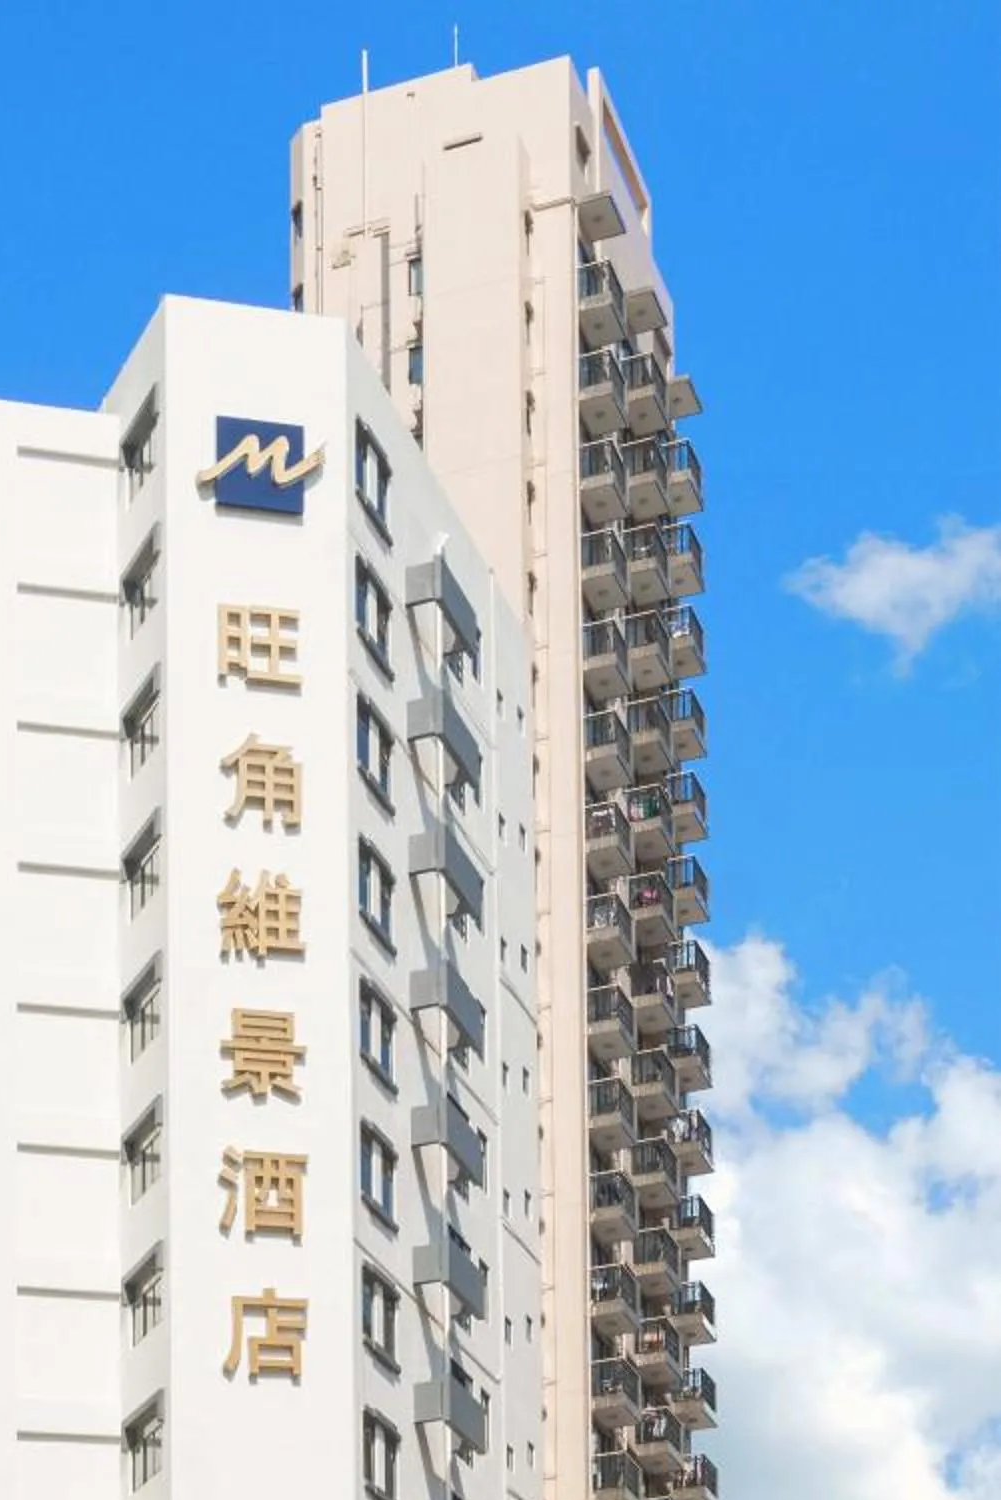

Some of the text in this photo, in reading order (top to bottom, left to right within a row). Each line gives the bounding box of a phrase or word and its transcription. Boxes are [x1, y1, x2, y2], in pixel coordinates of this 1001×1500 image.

[215, 603, 310, 1378] 旺角維景酒店
